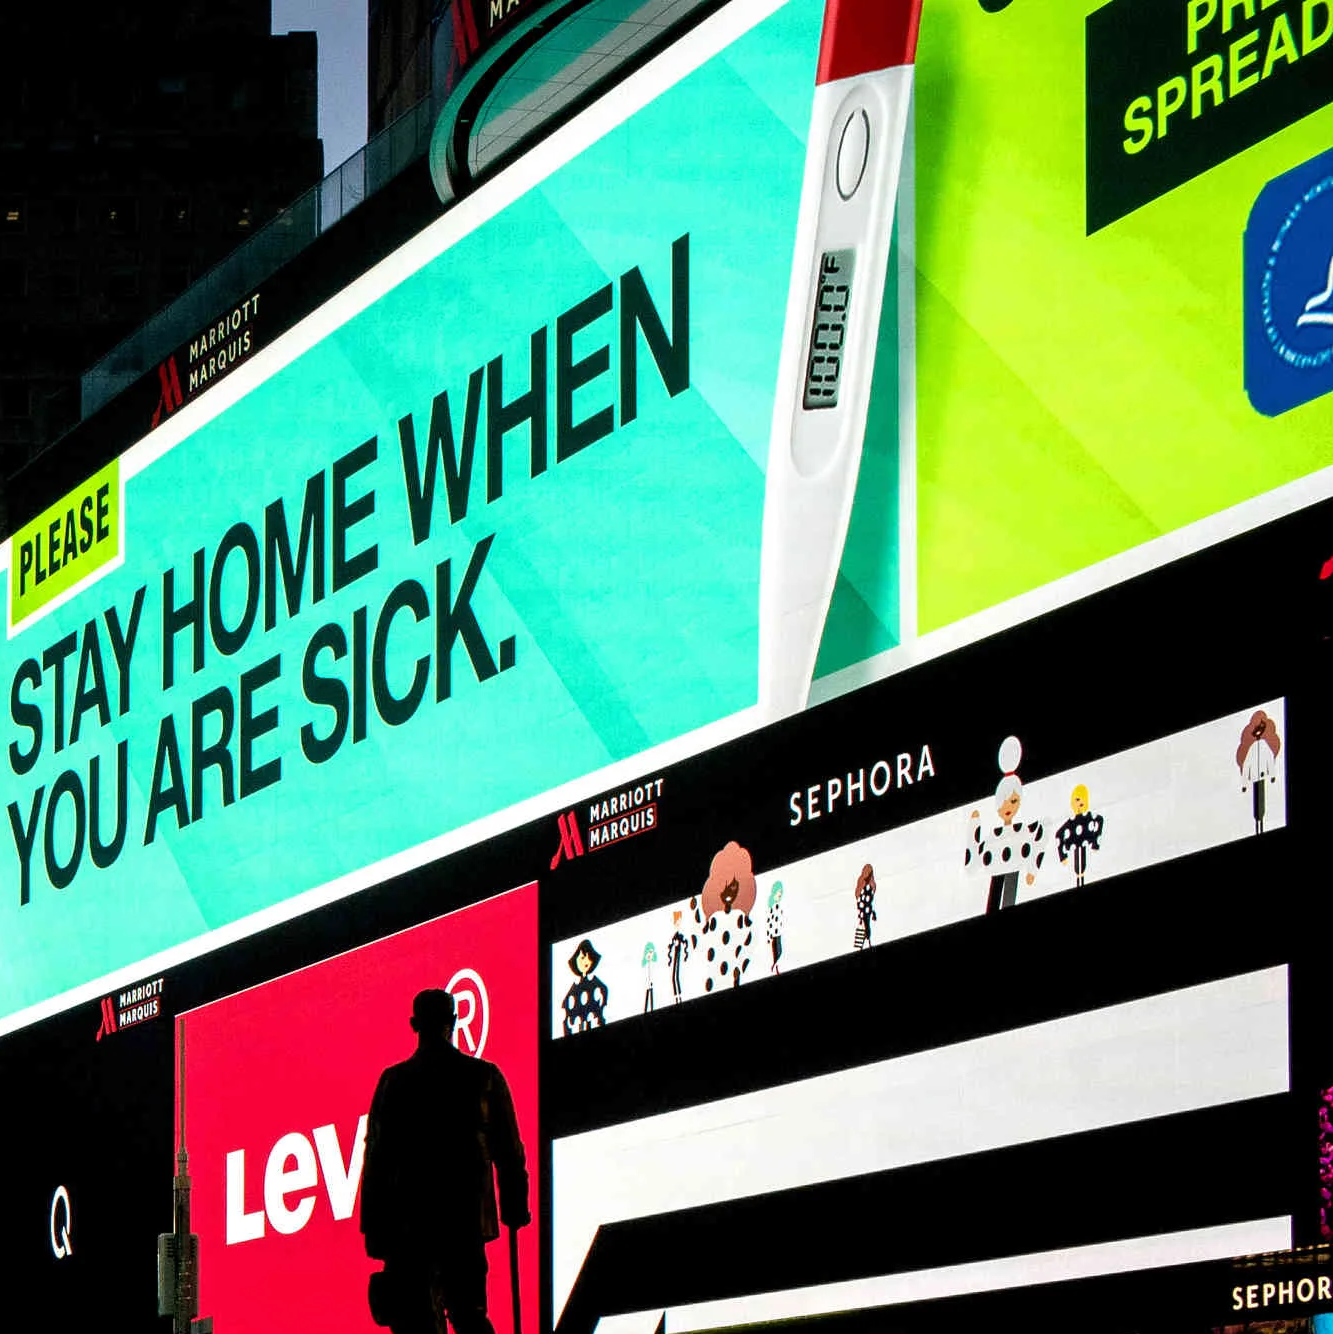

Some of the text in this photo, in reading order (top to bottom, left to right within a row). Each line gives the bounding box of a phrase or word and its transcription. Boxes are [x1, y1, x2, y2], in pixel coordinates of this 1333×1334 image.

[189, 293, 261, 364] MARRIOTT
[189, 330, 252, 394] MARQUIS
[7, 231, 691, 776] STAY HOME WHEN
[19, 482, 110, 598] PLEASE
[6, 533, 517, 907] YOU ARE SICK.
[589, 777, 665, 824] MARRIOTT
[789, 743, 937, 828] SEPHORA
[589, 806, 655, 848] MARQUIS
[119, 977, 164, 1008] MARRIOTT
[119, 999, 159, 1027] MARQUIS
[49, 1185, 73, 1259] Q
[1232, 1275, 1333, 1312] SEPHOR
